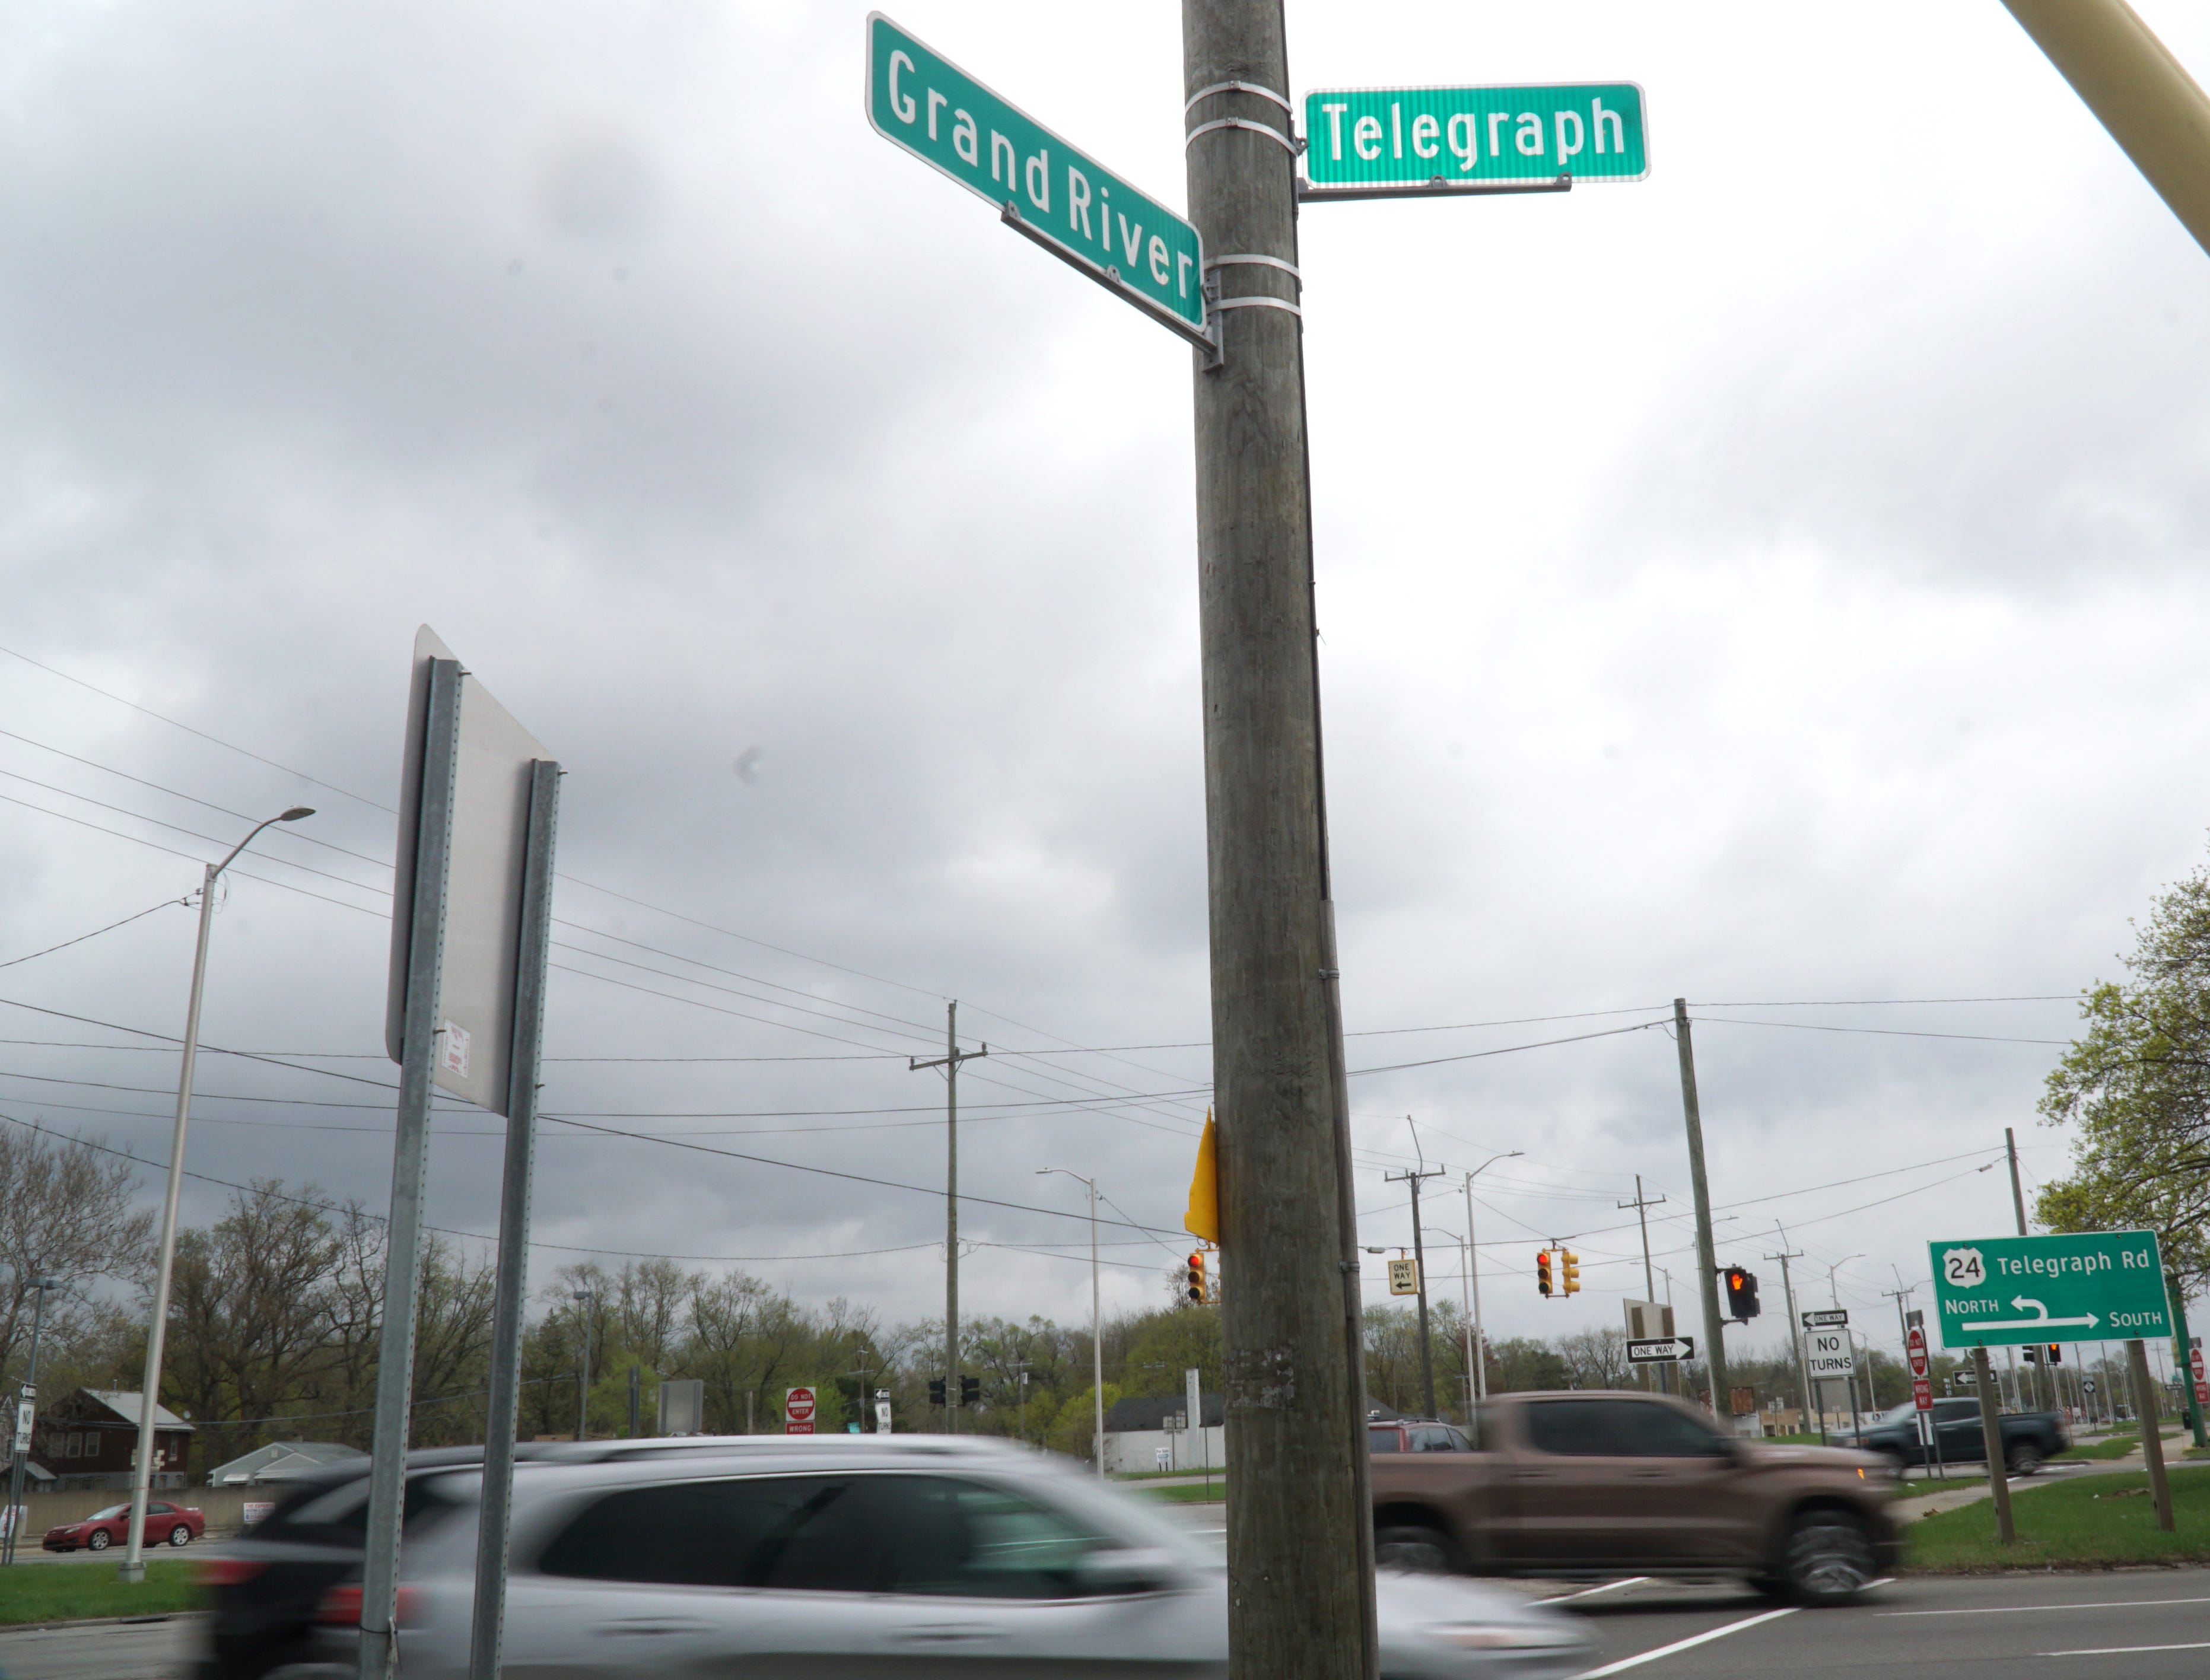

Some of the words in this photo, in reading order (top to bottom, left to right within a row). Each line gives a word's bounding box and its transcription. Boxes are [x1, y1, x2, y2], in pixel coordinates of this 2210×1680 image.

[1322, 97, 1624, 173] Telegraph
[889, 49, 1050, 213] Grand
[1069, 165, 1193, 300] River
[1949, 1256, 1980, 1279] 24
[1997, 1251, 2112, 1278] Telegraph
[2122, 1249, 2149, 1269] Rd
[1945, 1299, 1999, 1315] NORTH
[2109, 1311, 2163, 1327] SOUTH
[1634, 1346, 1652, 1356] ONE
[1655, 1345, 1674, 1354] WAY
[1817, 1337, 1839, 1352] NO
[1810, 1357, 1852, 1371] TURNS
[23, 1410, 30, 1425] NO
[882, 1407, 889, 1417] NO
